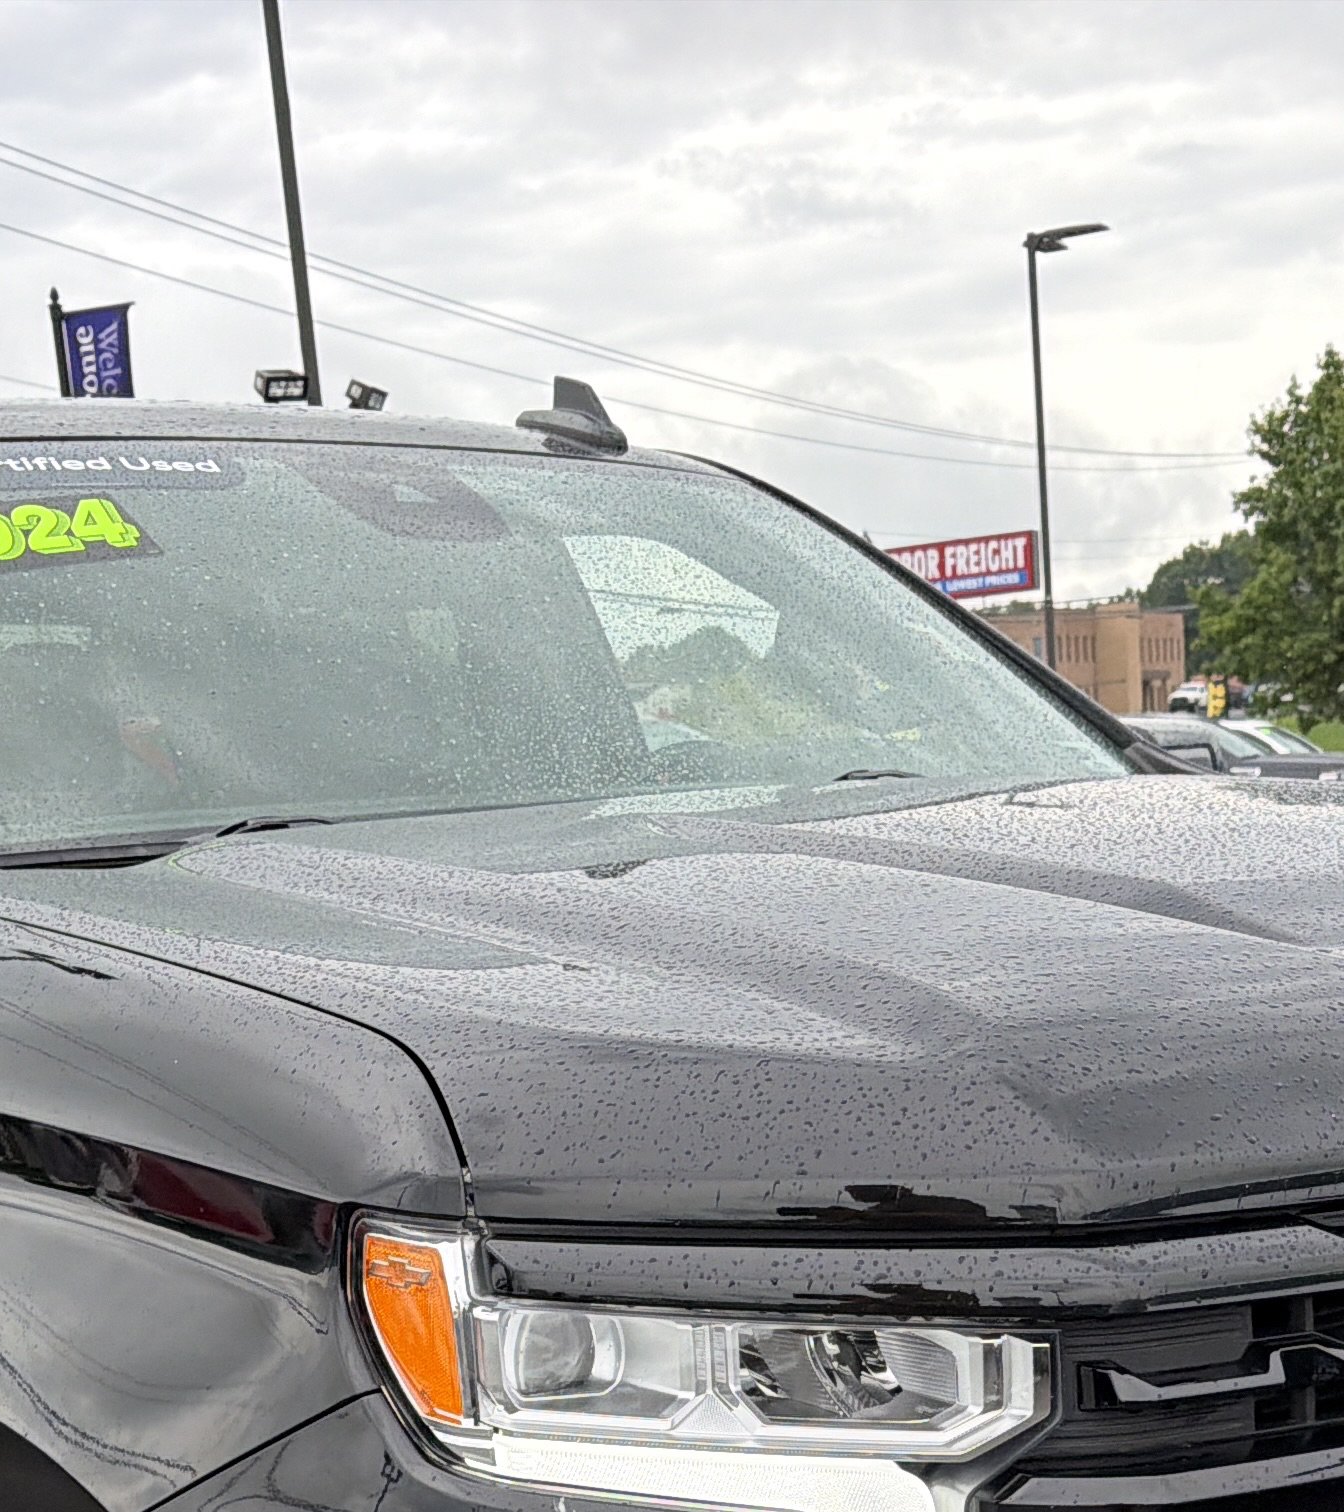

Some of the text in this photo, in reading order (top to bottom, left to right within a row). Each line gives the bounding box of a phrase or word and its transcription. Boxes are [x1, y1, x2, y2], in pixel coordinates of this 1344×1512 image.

[76, 324, 99, 395] ome
[118, 456, 221, 473] Used
[943, 536, 1027, 579] FREIGHT
